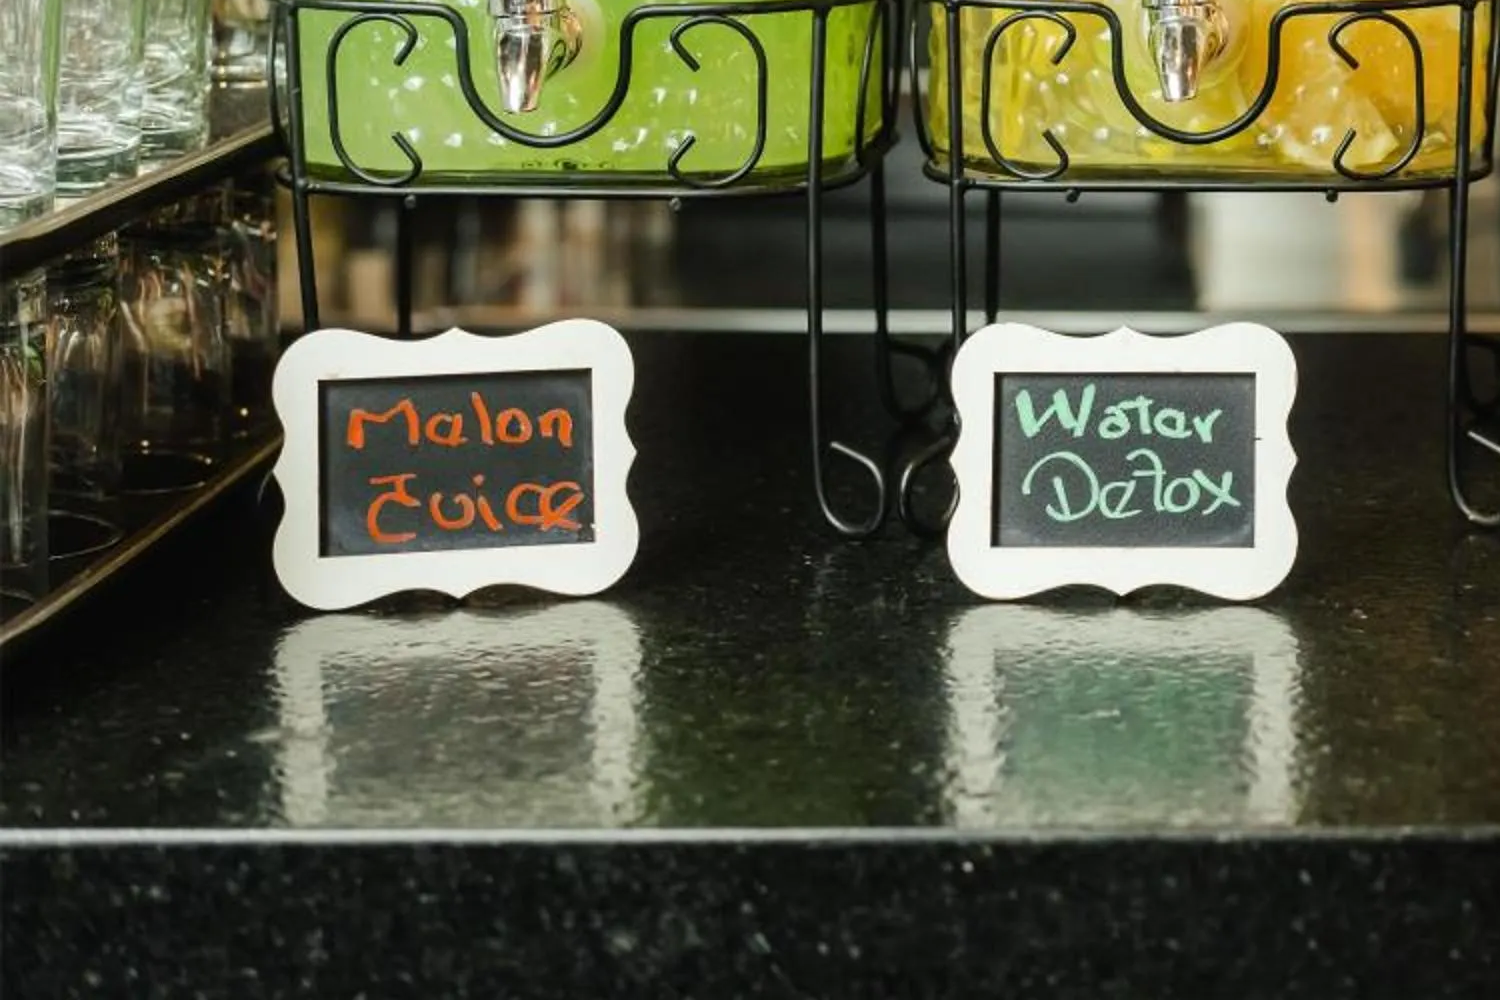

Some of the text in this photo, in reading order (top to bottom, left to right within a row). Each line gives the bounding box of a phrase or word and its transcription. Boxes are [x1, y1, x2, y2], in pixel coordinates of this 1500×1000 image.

[1015, 383, 1223, 443] Water
[366, 473, 585, 544] Juice
[1021, 448, 1241, 522] Detox
